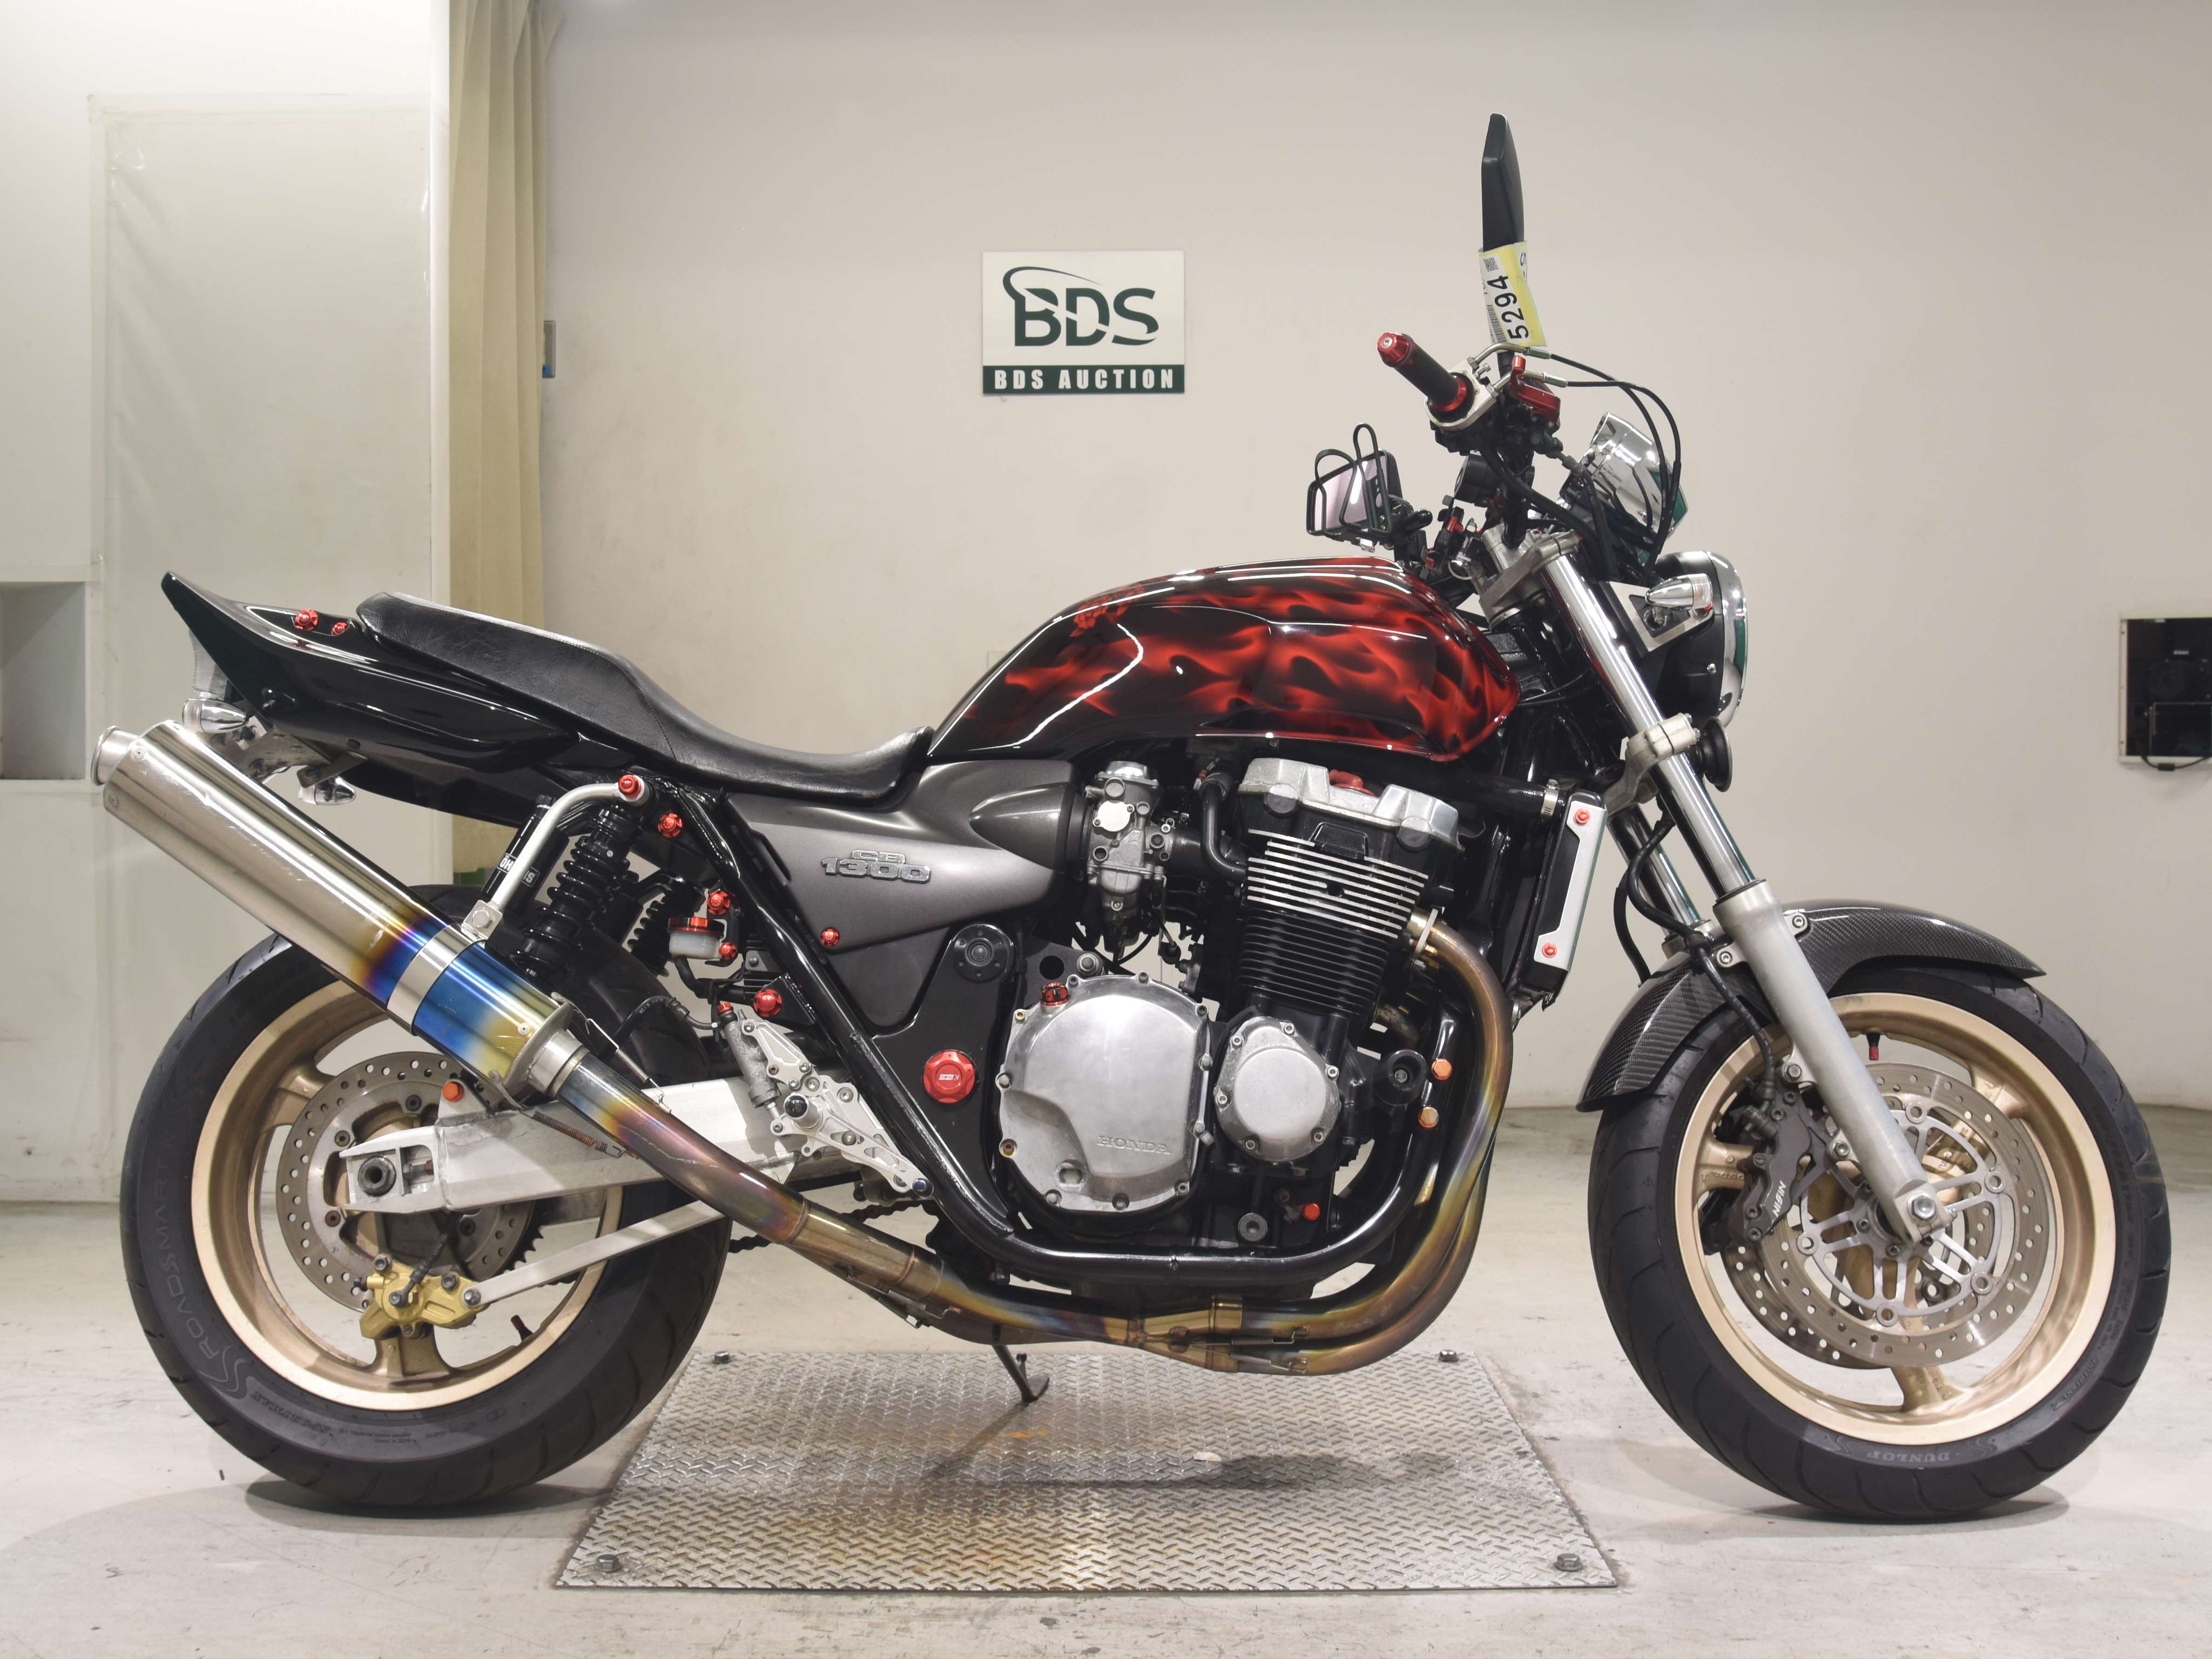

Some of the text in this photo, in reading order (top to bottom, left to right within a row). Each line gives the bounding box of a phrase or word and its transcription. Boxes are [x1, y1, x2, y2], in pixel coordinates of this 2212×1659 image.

[1003, 266, 1159, 346] BDS
[1487, 275, 1529, 339] 5294
[994, 369, 1173, 389] BDS AUCTION
[851, 849, 906, 864] CB
[821, 857, 932, 884] 1300
[1097, 1135, 1170, 1155] HONDA
[1867, 1451, 1951, 1462] DUNLOP
